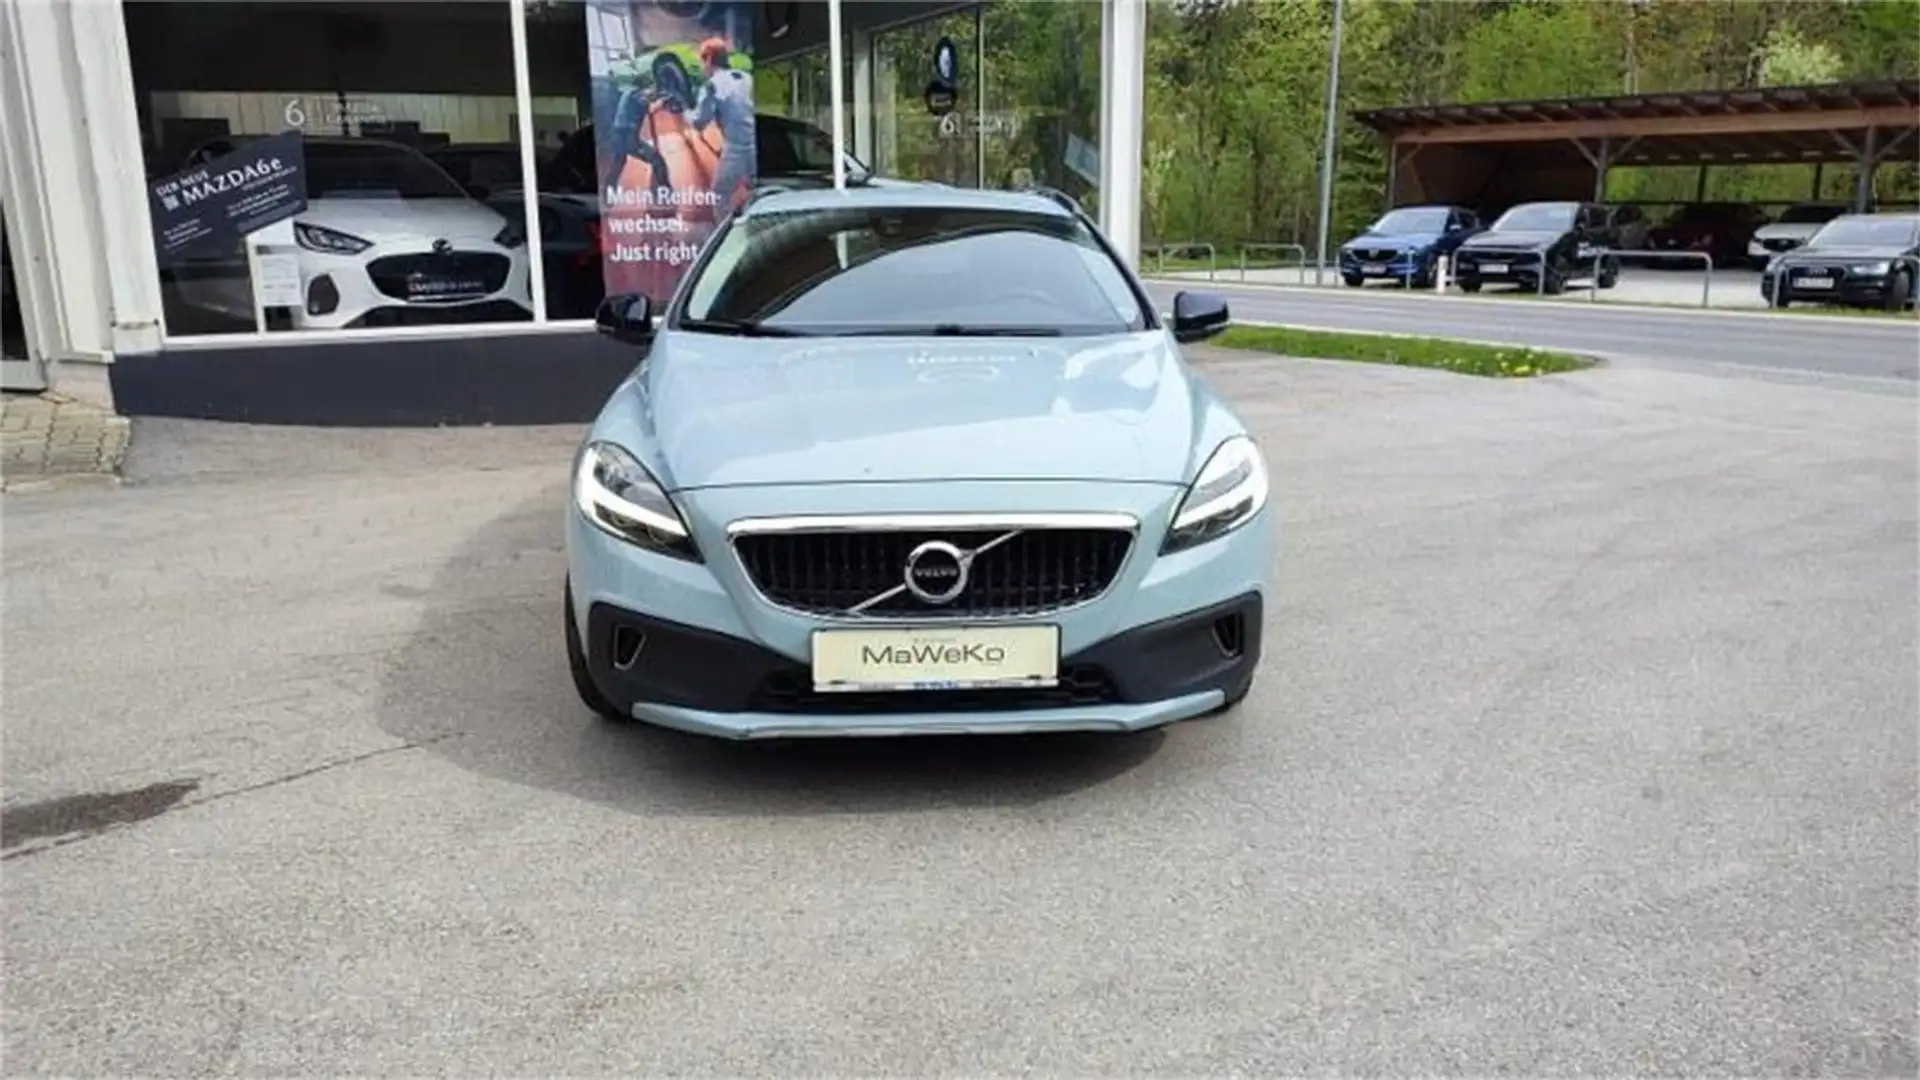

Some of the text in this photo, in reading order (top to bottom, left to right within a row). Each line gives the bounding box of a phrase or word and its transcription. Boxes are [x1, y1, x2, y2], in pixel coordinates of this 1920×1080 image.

[285, 99, 305, 127] 6
[181, 157, 283, 206] MAZDA6e
[606, 185, 722, 206] Mein Reifen-
[608, 213, 689, 233] wechsel.
[610, 241, 699, 266] Just right
[862, 643, 1005, 665] MaWeKo
